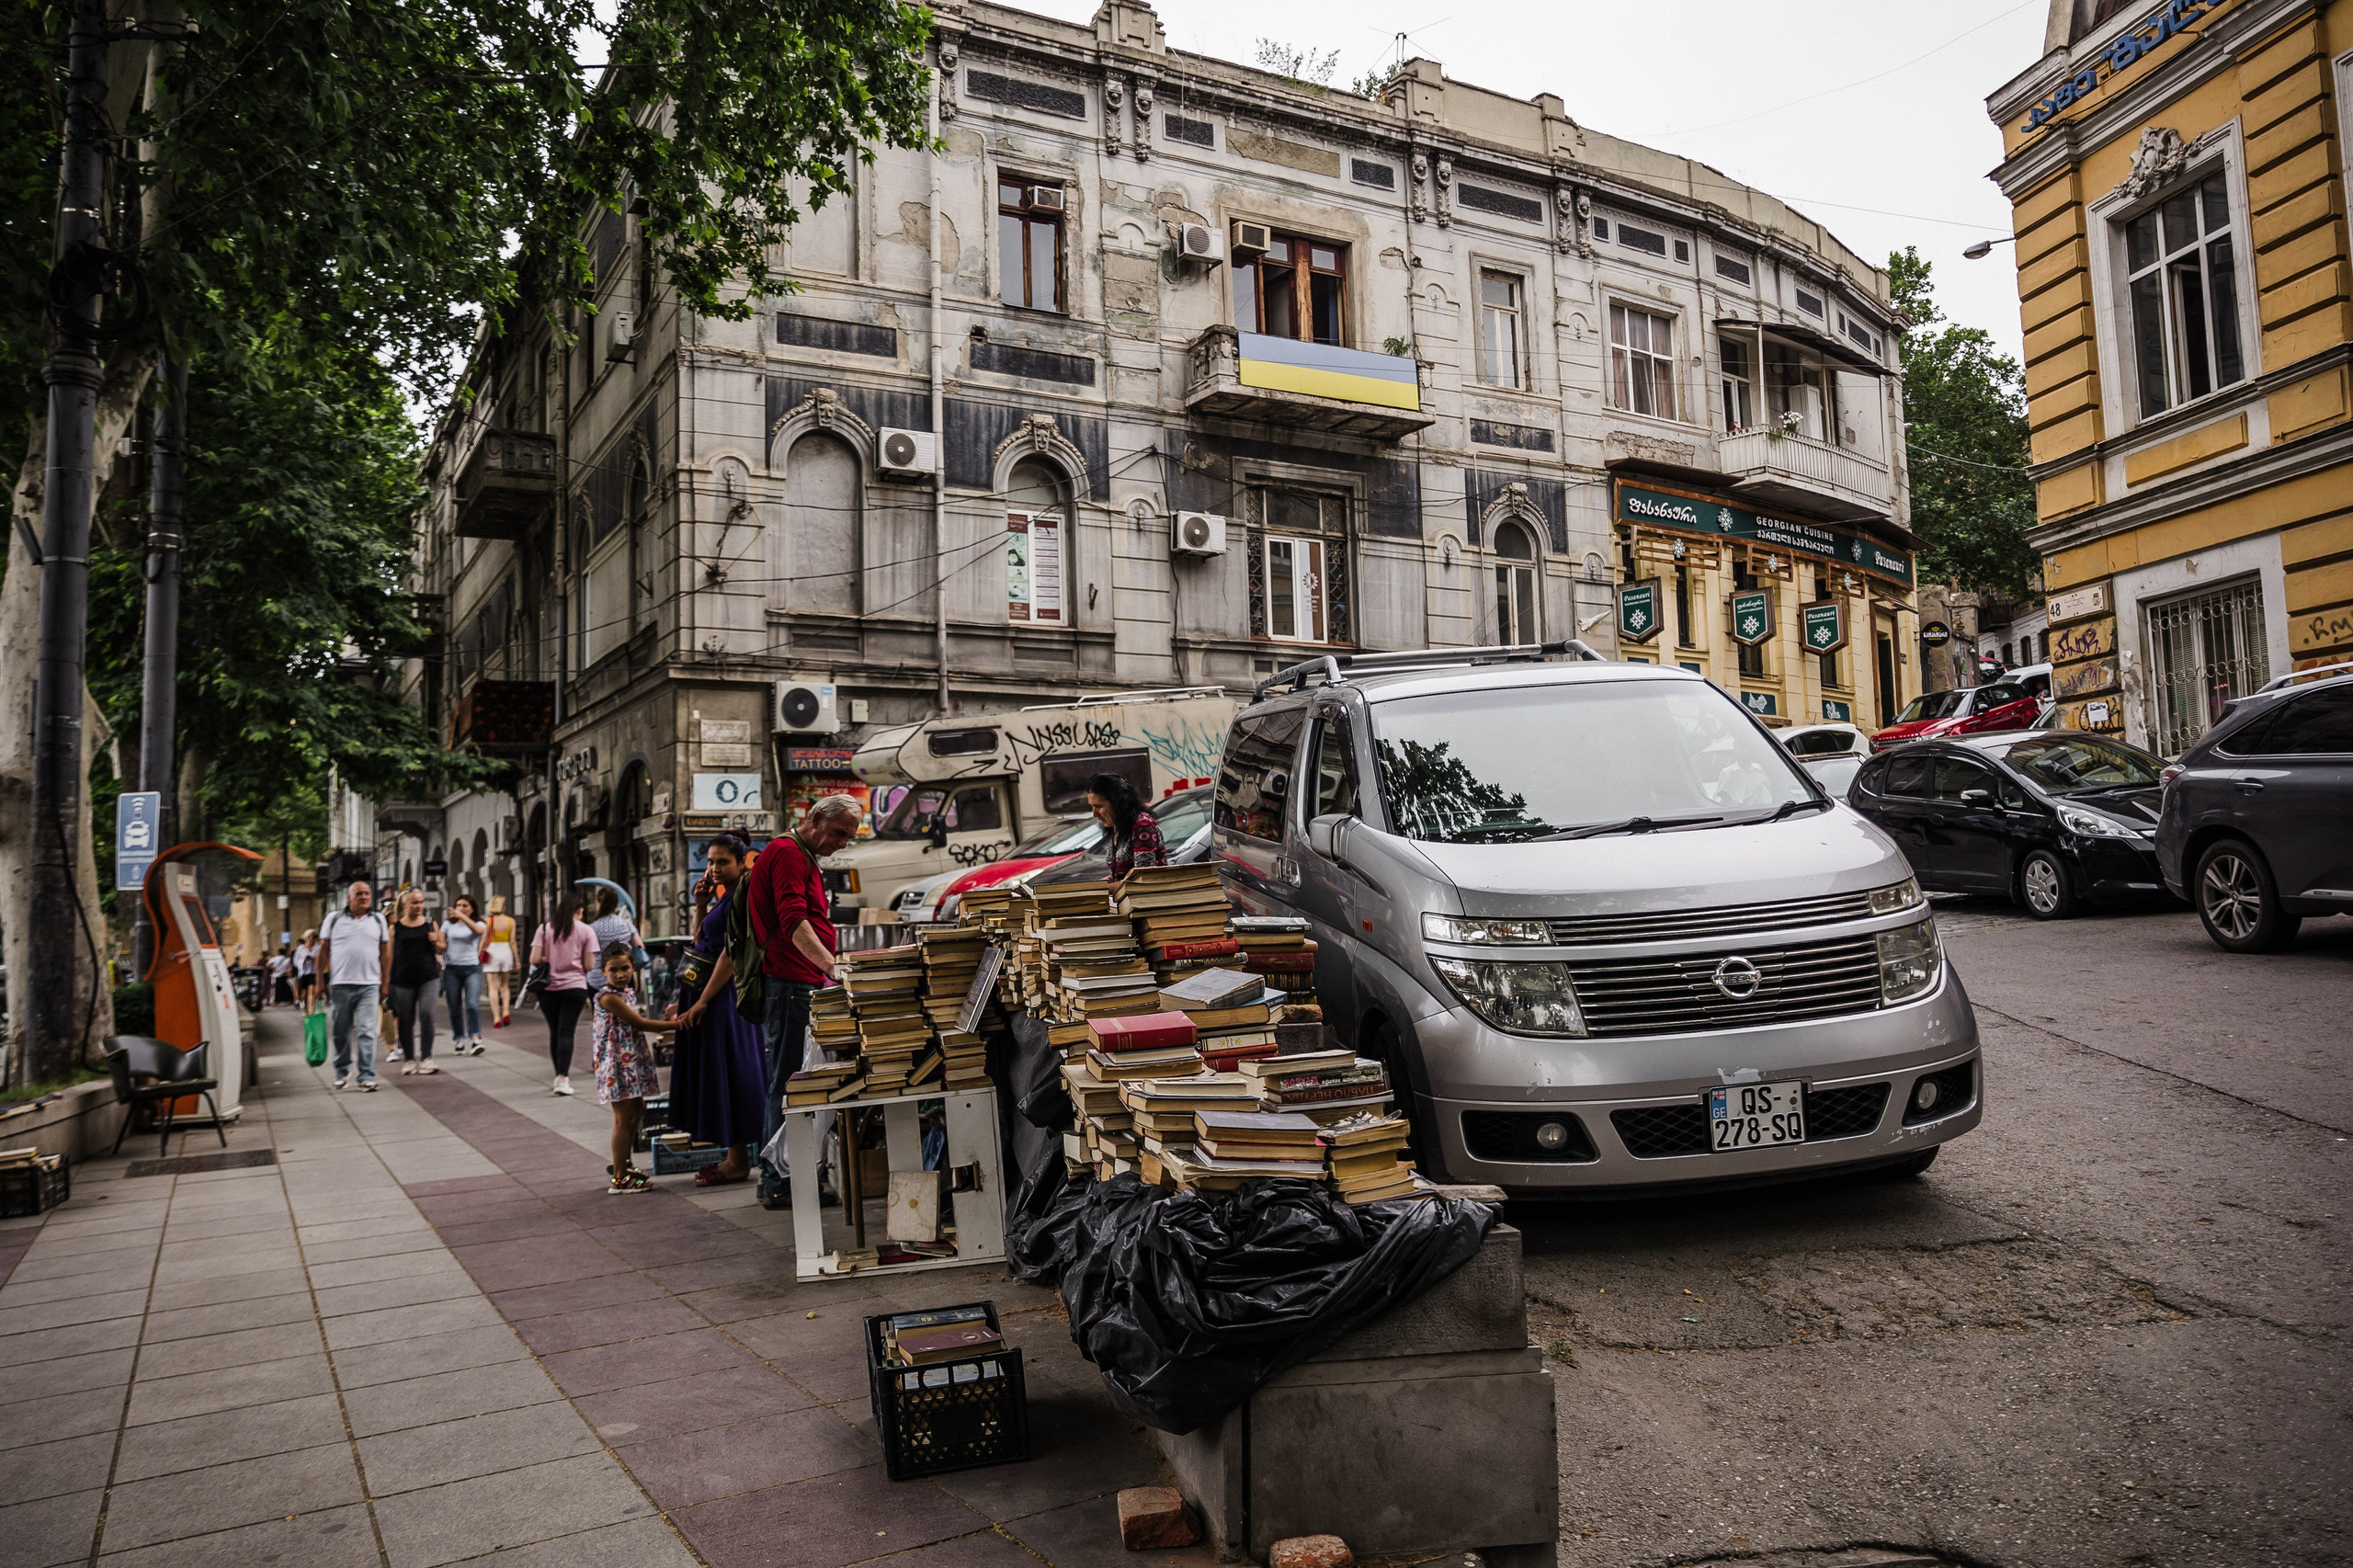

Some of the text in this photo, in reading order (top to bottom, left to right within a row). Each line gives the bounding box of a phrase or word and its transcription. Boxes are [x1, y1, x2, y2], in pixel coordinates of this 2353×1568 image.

[2021, 70, 2098, 133] კაფე
[1629, 497, 1698, 524] ფასანაური
[1756, 516, 1834, 542] GEORGIAN CUISINE
[2050, 602, 2062, 617] 48
[793, 758, 841, 769] TATTOO
[1721, 974, 1757, 984] NISSAN
[1287, 1085, 1374, 1103] ПАБЛО НЕРУДА
[1712, 1107, 1726, 1119] GE
[1715, 1112, 1802, 1148] 278-SQ
